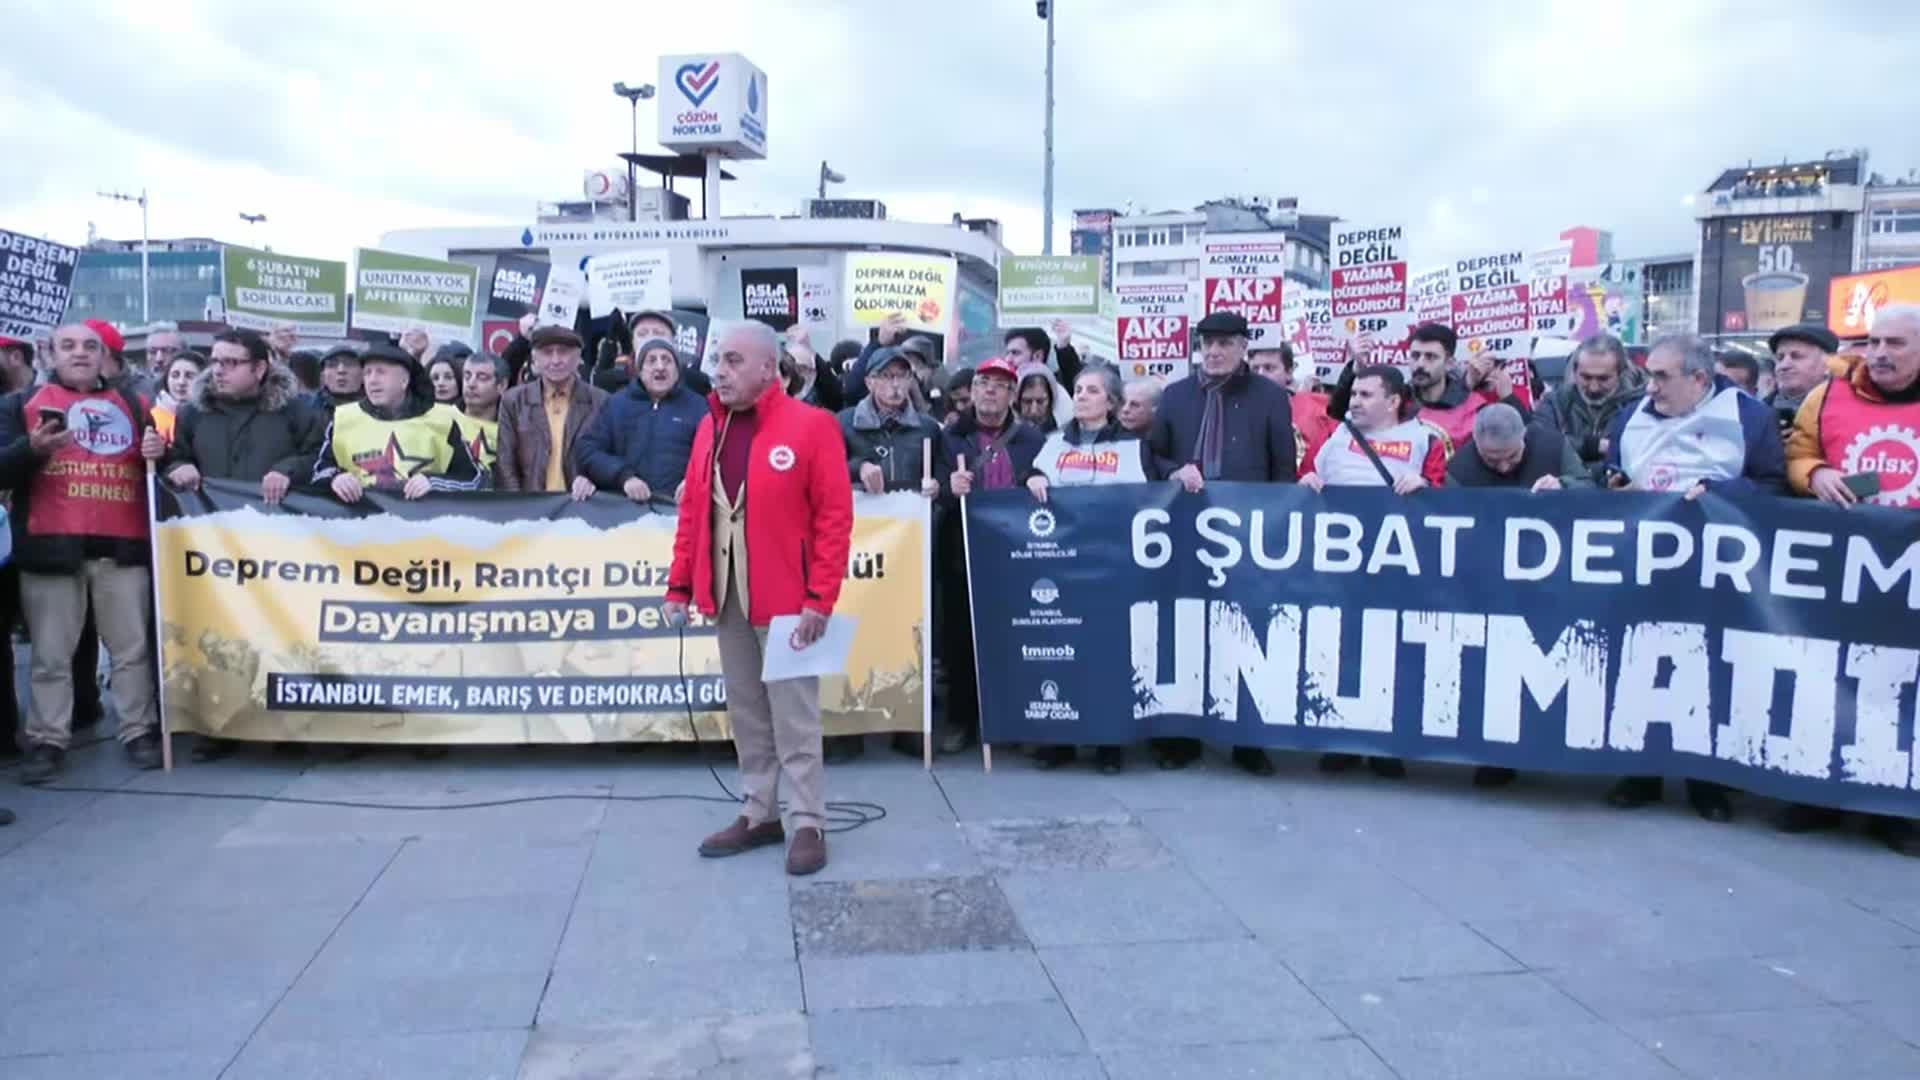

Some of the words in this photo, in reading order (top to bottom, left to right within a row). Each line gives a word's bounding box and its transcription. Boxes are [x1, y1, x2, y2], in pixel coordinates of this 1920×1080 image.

[677, 111, 718, 124] ÇÖZÜM
[672, 124, 722, 135] NOKTASI
[539, 231, 588, 240] İSTANBUL
[1338, 227, 1400, 246] DEPREM
[0, 233, 76, 266] DEPREM
[1339, 242, 1398, 266] DEĞİL
[1210, 255, 1247, 264] ACIMIZ
[1250, 254, 1280, 263] HALA
[1457, 252, 1523, 272] DEPREM
[7, 255, 58, 281] DEĞİL
[856, 268, 904, 279] DEPREM
[908, 267, 943, 284] DEĞİL
[1231, 266, 1258, 274] TAZE
[1342, 266, 1394, 283] YAĞMA
[0, 272, 29, 288] ANT
[365, 272, 432, 286] UNUTMAK
[436, 276, 464, 288] YOK
[496, 269, 536, 288] ASLA
[1460, 268, 1520, 291] DEĞİL
[0, 284, 65, 312] ESABINI
[745, 283, 788, 296] ASLA
[1211, 279, 1276, 302] AKP
[1465, 288, 1518, 308] YAĞMA
[432, 295, 468, 308] YOK!
[1121, 296, 1155, 304] ACIMIZ
[1158, 295, 1184, 304] HALA
[1335, 296, 1400, 315] ÖLDÜRDÜ!
[806, 308, 826, 318] SOL
[1141, 306, 1165, 314] TAZE
[1210, 302, 1276, 322] İİFA!
[1124, 318, 1182, 340] AKP
[1359, 319, 1388, 332] SEP
[1456, 318, 1525, 336] ÖLDÜRDÜ!
[1538, 318, 1556, 330] SEP
[1248, 328, 1264, 340] EP
[1122, 340, 1183, 358] İSTİFA!
[1486, 338, 1512, 351] SEP
[1149, 363, 1174, 376] SEP
[1316, 366, 1331, 376] EP
[1861, 452, 1915, 474] DİSK
[1131, 508, 1172, 568] 6
[1195, 507, 1476, 588] ŞUBAT
[1504, 517, 1920, 610] DEPREM
[184, 550, 340, 586] Deprem
[354, 560, 462, 594] Değil,
[475, 563, 590, 593] Rantçı
[603, 562, 673, 587] Düz
[323, 604, 595, 640] Dayanışmaya
[1022, 644, 1076, 656] tmmob
[276, 676, 386, 705] İSTANBUL
[392, 684, 458, 710] EMEK,
[467, 686, 532, 711] BARIŞ
[539, 686, 564, 704] VE
[570, 682, 694, 705] DEMOKRASİ
[701, 682, 727, 702] GÜ
[1130, 598, 1920, 790] UNUTMADI
